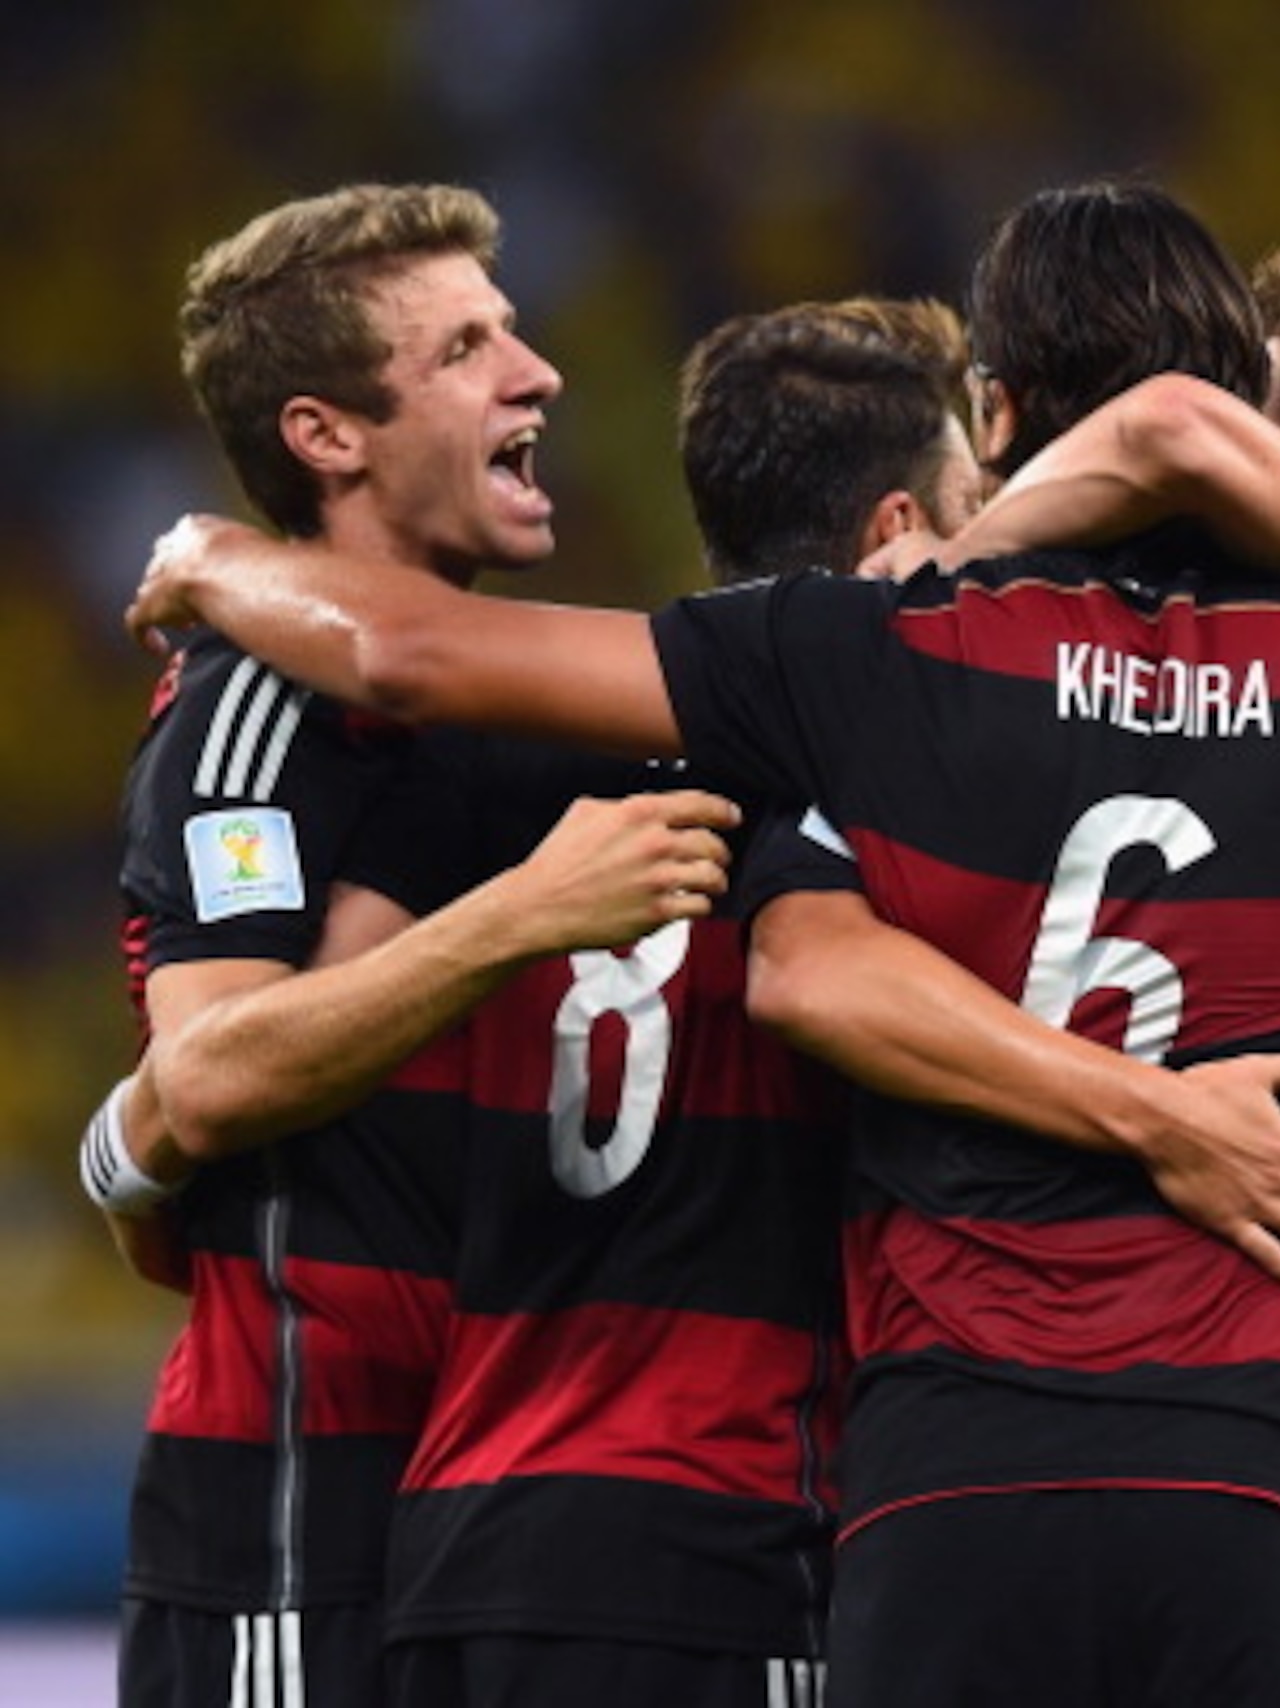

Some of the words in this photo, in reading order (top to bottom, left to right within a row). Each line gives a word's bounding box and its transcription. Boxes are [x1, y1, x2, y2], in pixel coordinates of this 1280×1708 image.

[1056, 641, 1275, 738] KHEDIRA
[549, 917, 691, 1198] 8
[1020, 794, 1218, 1066] 6
